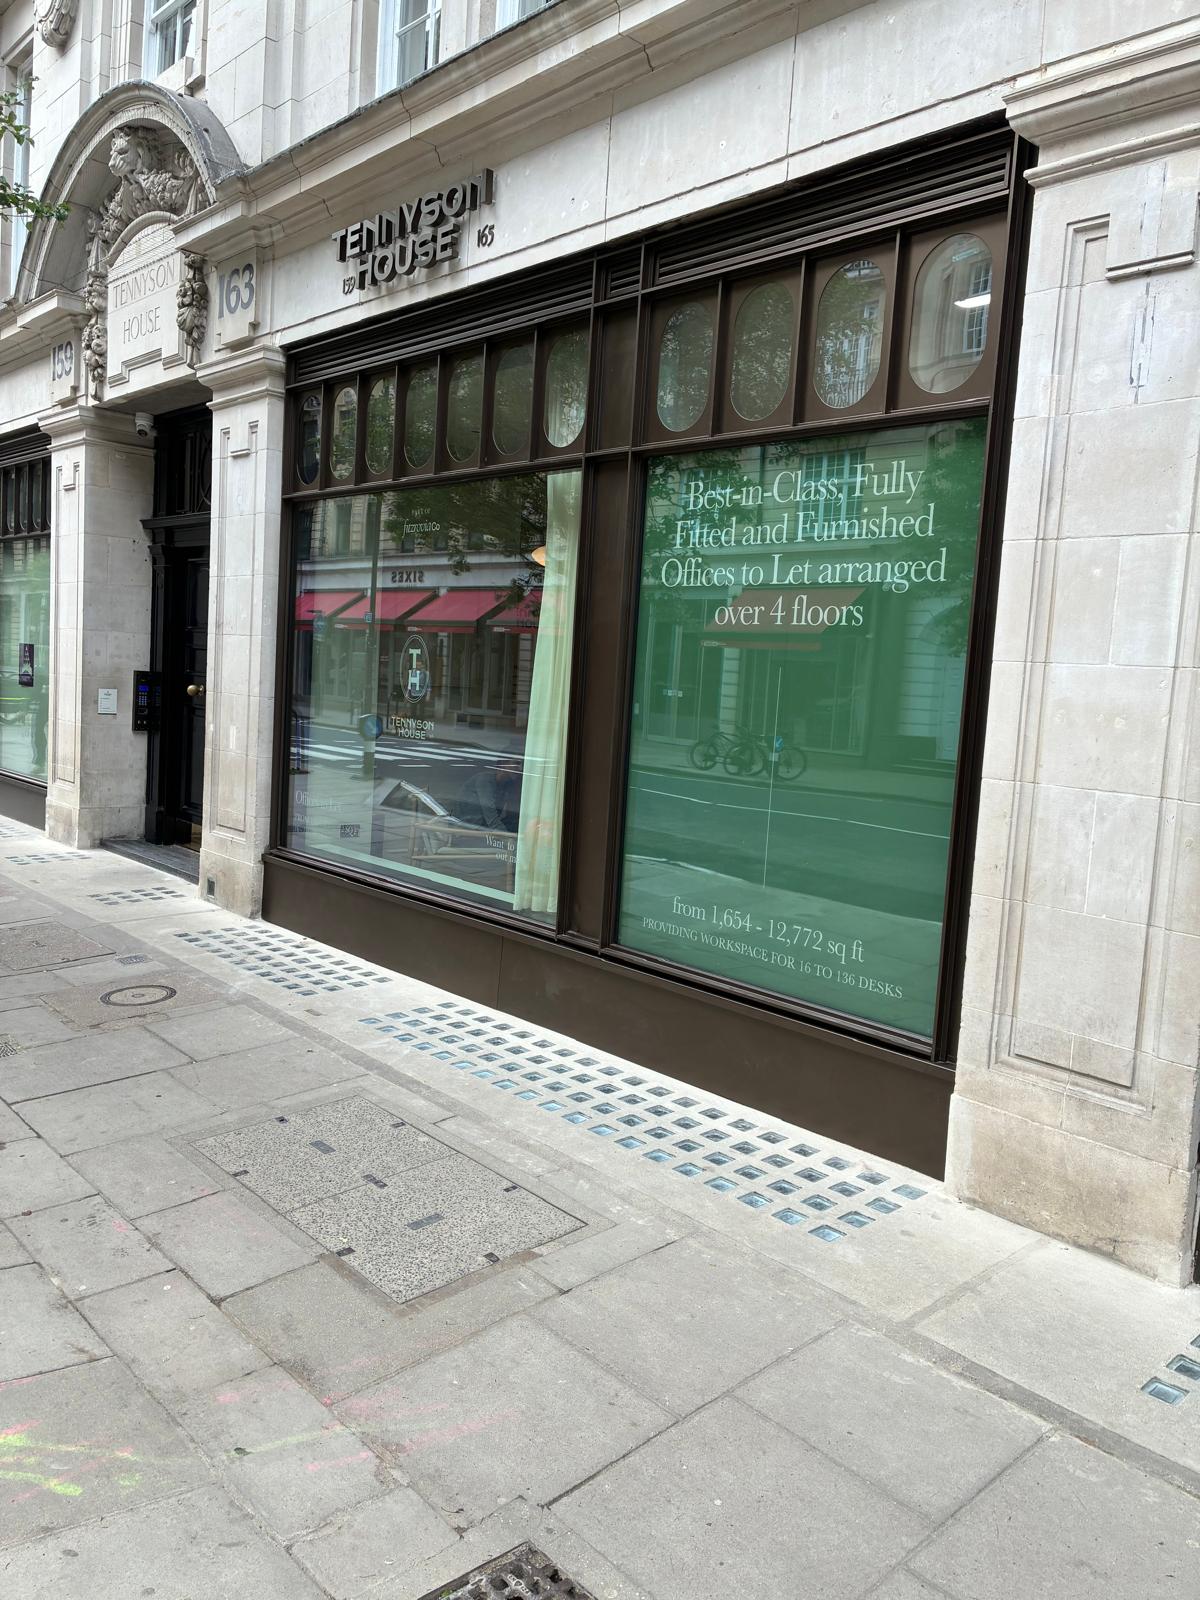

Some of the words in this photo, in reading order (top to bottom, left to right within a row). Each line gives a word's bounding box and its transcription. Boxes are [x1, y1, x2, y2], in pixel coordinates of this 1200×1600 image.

[331, 167, 494, 263] TENNYSON
[342, 275, 356, 295] 159
[356, 222, 461, 290] HOUSE
[477, 224, 495, 248] 165
[113, 258, 175, 309] TENNYSON
[217, 263, 255, 320] 163
[123, 306, 161, 344] HOUSE
[51, 340, 75, 382] 159
[686, 469, 844, 511] Best-in-Class,
[852, 460, 925, 504] Fully
[673, 516, 737, 549] Fitted
[742, 513, 789, 546] and
[793, 503, 935, 543] Furnished
[661, 557, 736, 588] Offices
[741, 561, 764, 587] to
[769, 553, 813, 586] Let
[818, 547, 947, 594] arranged
[714, 605, 765, 626] over
[769, 595, 786, 625] 4
[790, 594, 864, 627] floors
[407, 670, 421, 691] H
[408, 648, 421, 669] T
[391, 716, 435, 731] TENNYSON
[398, 729, 426, 739] HOUSE
[485, 834, 504, 849] Want
[672, 895, 706, 921] from
[711, 905, 753, 933] 1,654
[768, 919, 823, 951] 12,772
[827, 940, 847, 965] sq
[850, 939, 865, 963] ft
[642, 917, 698, 942] PROVIDING
[700, 932, 769, 961] WORKSPACE
[771, 951, 796, 970] FOR
[800, 960, 811, 974] 16
[814, 963, 833, 979] TO
[837, 970, 856, 986] 136
[858, 976, 903, 999] DESKS
